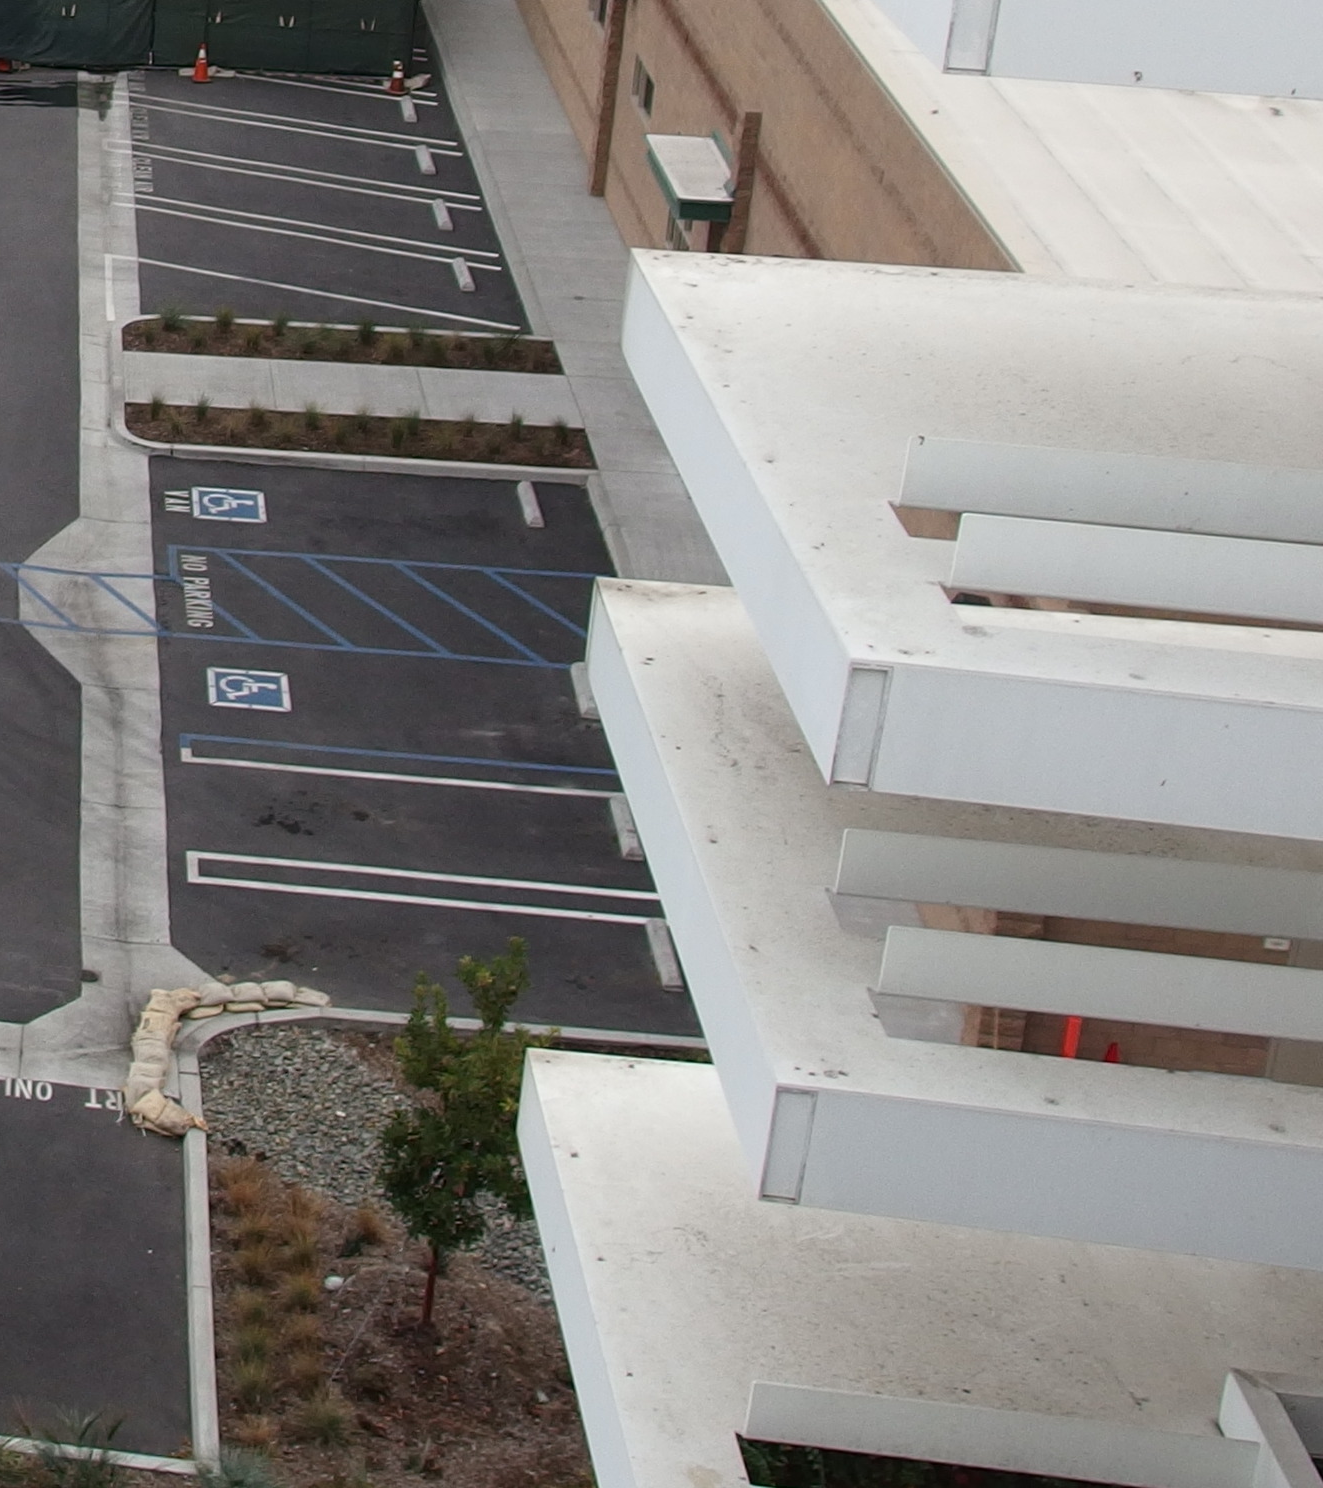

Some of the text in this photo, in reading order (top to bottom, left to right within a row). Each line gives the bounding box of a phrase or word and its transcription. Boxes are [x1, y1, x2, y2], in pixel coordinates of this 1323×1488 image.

[164, 490, 191, 513] VAN
[180, 554, 215, 629] NO PARKING
